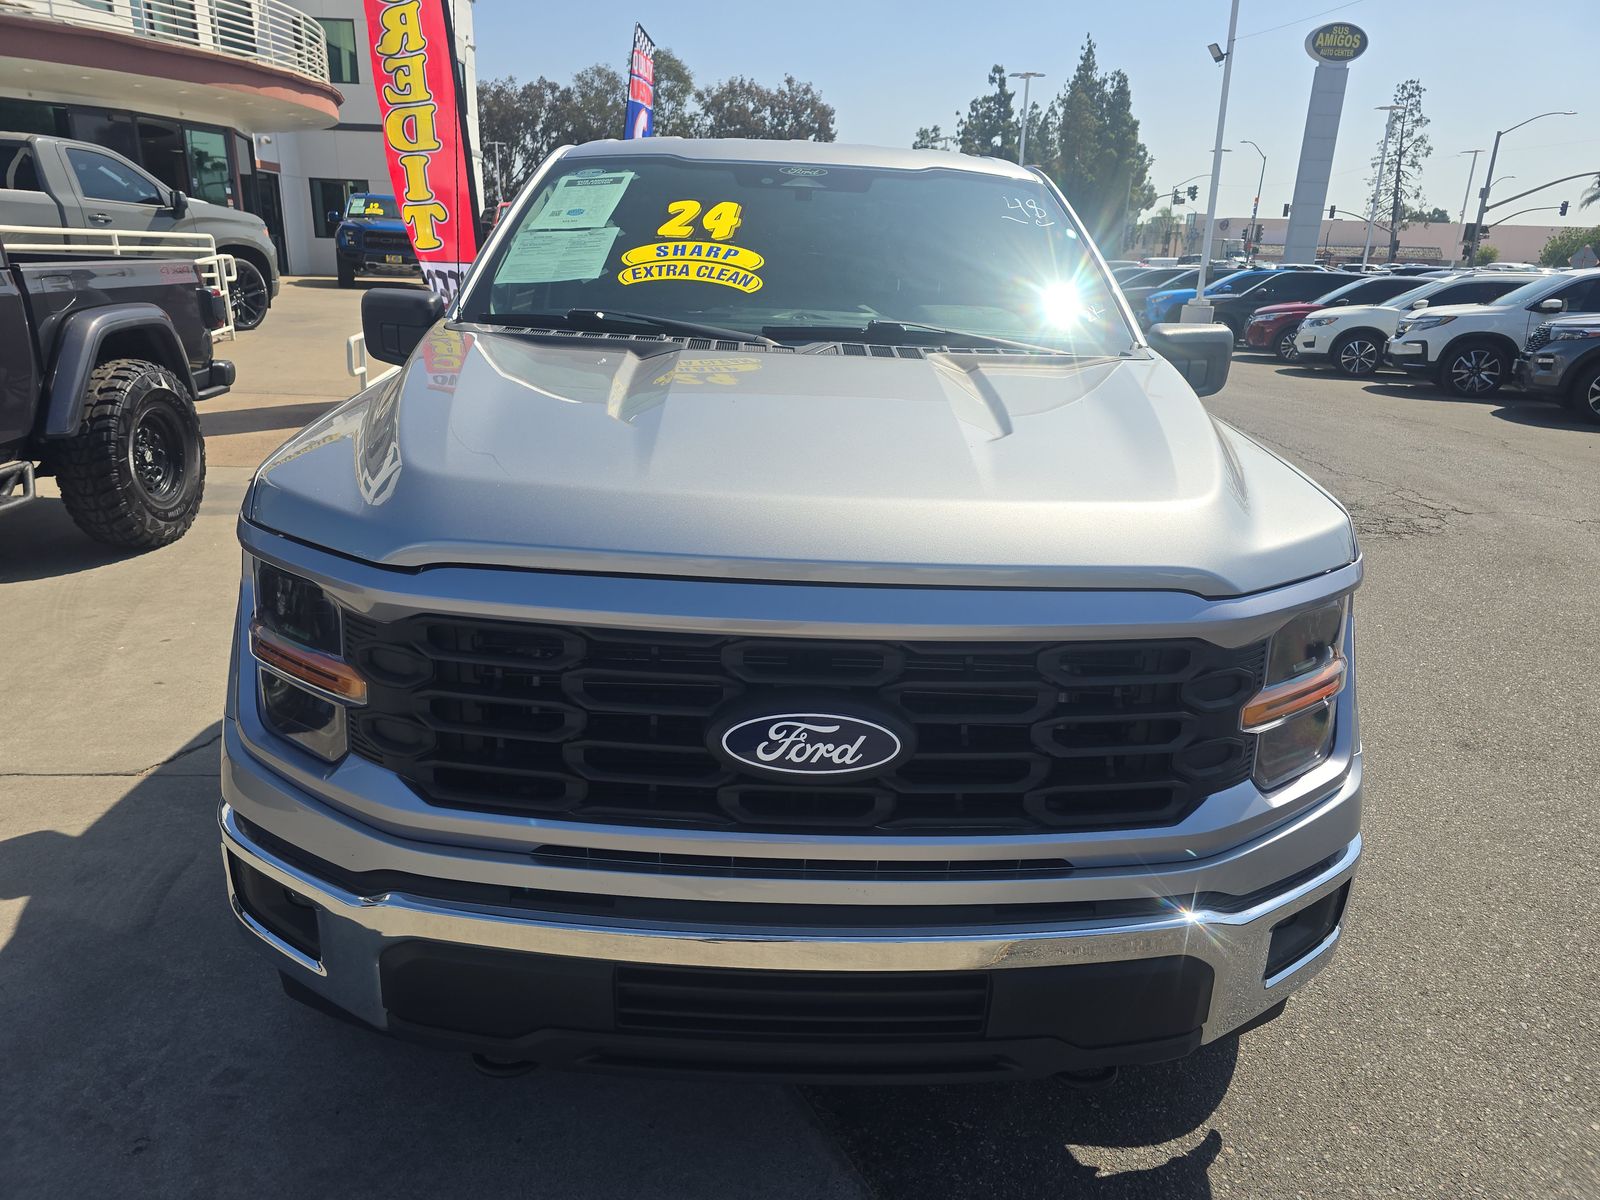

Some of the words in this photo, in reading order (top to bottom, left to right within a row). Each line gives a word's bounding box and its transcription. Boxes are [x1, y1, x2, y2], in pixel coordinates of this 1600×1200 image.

[1332, 26, 1350, 35] SUS
[1316, 32, 1361, 49] AMIGOS
[1320, 48, 1334, 57] AUTO
[1334, 48, 1354, 57] CENTER
[656, 199, 742, 241] 24
[655, 244, 740, 261] SHARP
[631, 263, 690, 281] EXTRA
[696, 265, 756, 288] CLEAN
[756, 721, 867, 765] Ford
